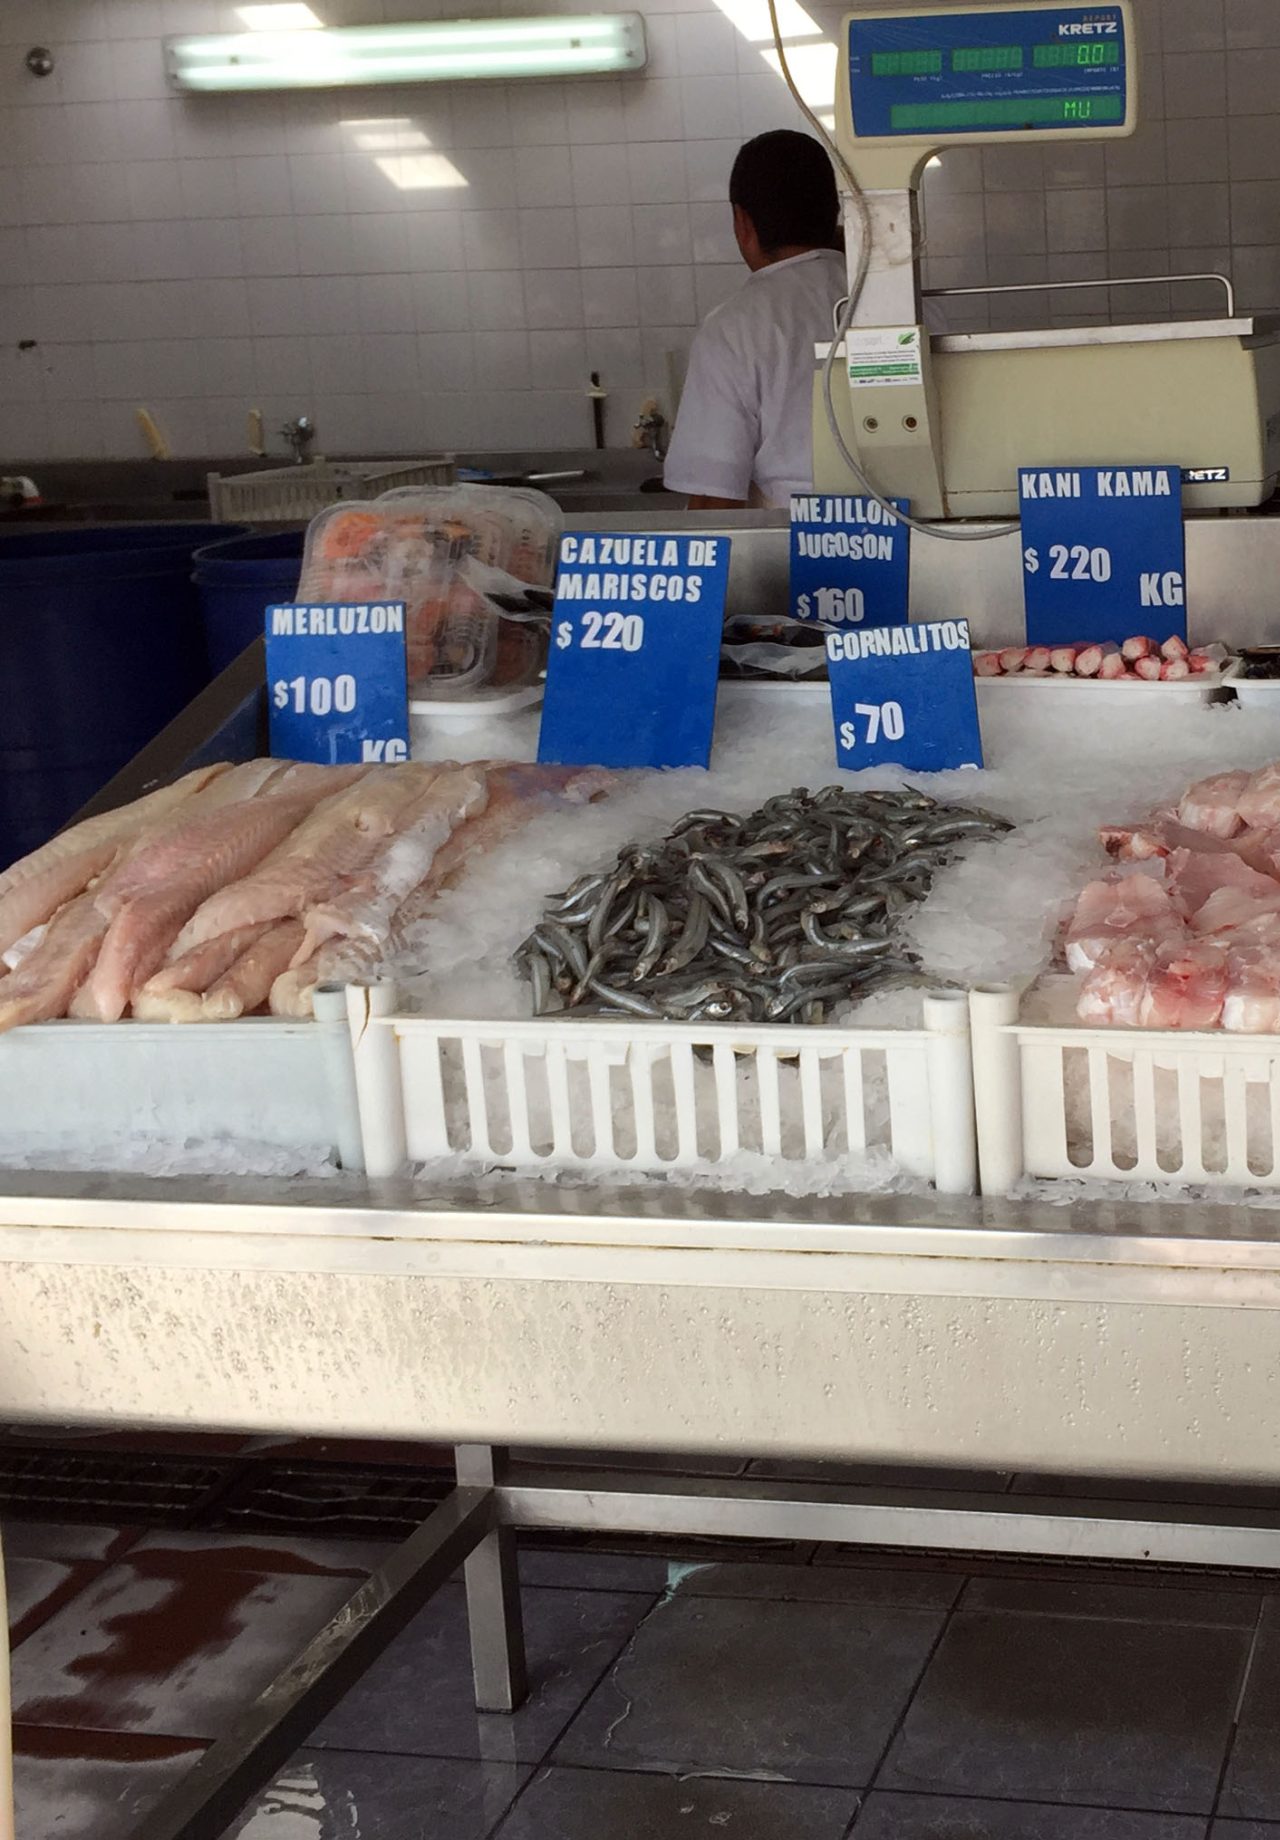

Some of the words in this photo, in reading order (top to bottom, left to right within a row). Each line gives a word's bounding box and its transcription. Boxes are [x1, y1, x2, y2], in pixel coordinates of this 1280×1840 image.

[1058, 22, 1118, 36] KRETZ
[1064, 101, 1090, 119] MU
[1021, 472, 1081, 499] KANI
[1097, 470, 1171, 497] KAMA
[789, 497, 899, 527] MEJILLON
[560, 536, 679, 567] CAZUELA
[687, 540, 718, 567] DE
[797, 531, 893, 561] JUGOSON
[1024, 547, 1039, 574] $
[1049, 544, 1111, 582] 220
[556, 573, 702, 603] MARISCOS
[1139, 571, 1184, 606] KG
[271, 604, 404, 636] MERLUZON
[556, 621, 573, 650] $
[580, 611, 644, 652] 220
[826, 620, 969, 661] CORNALITOS
